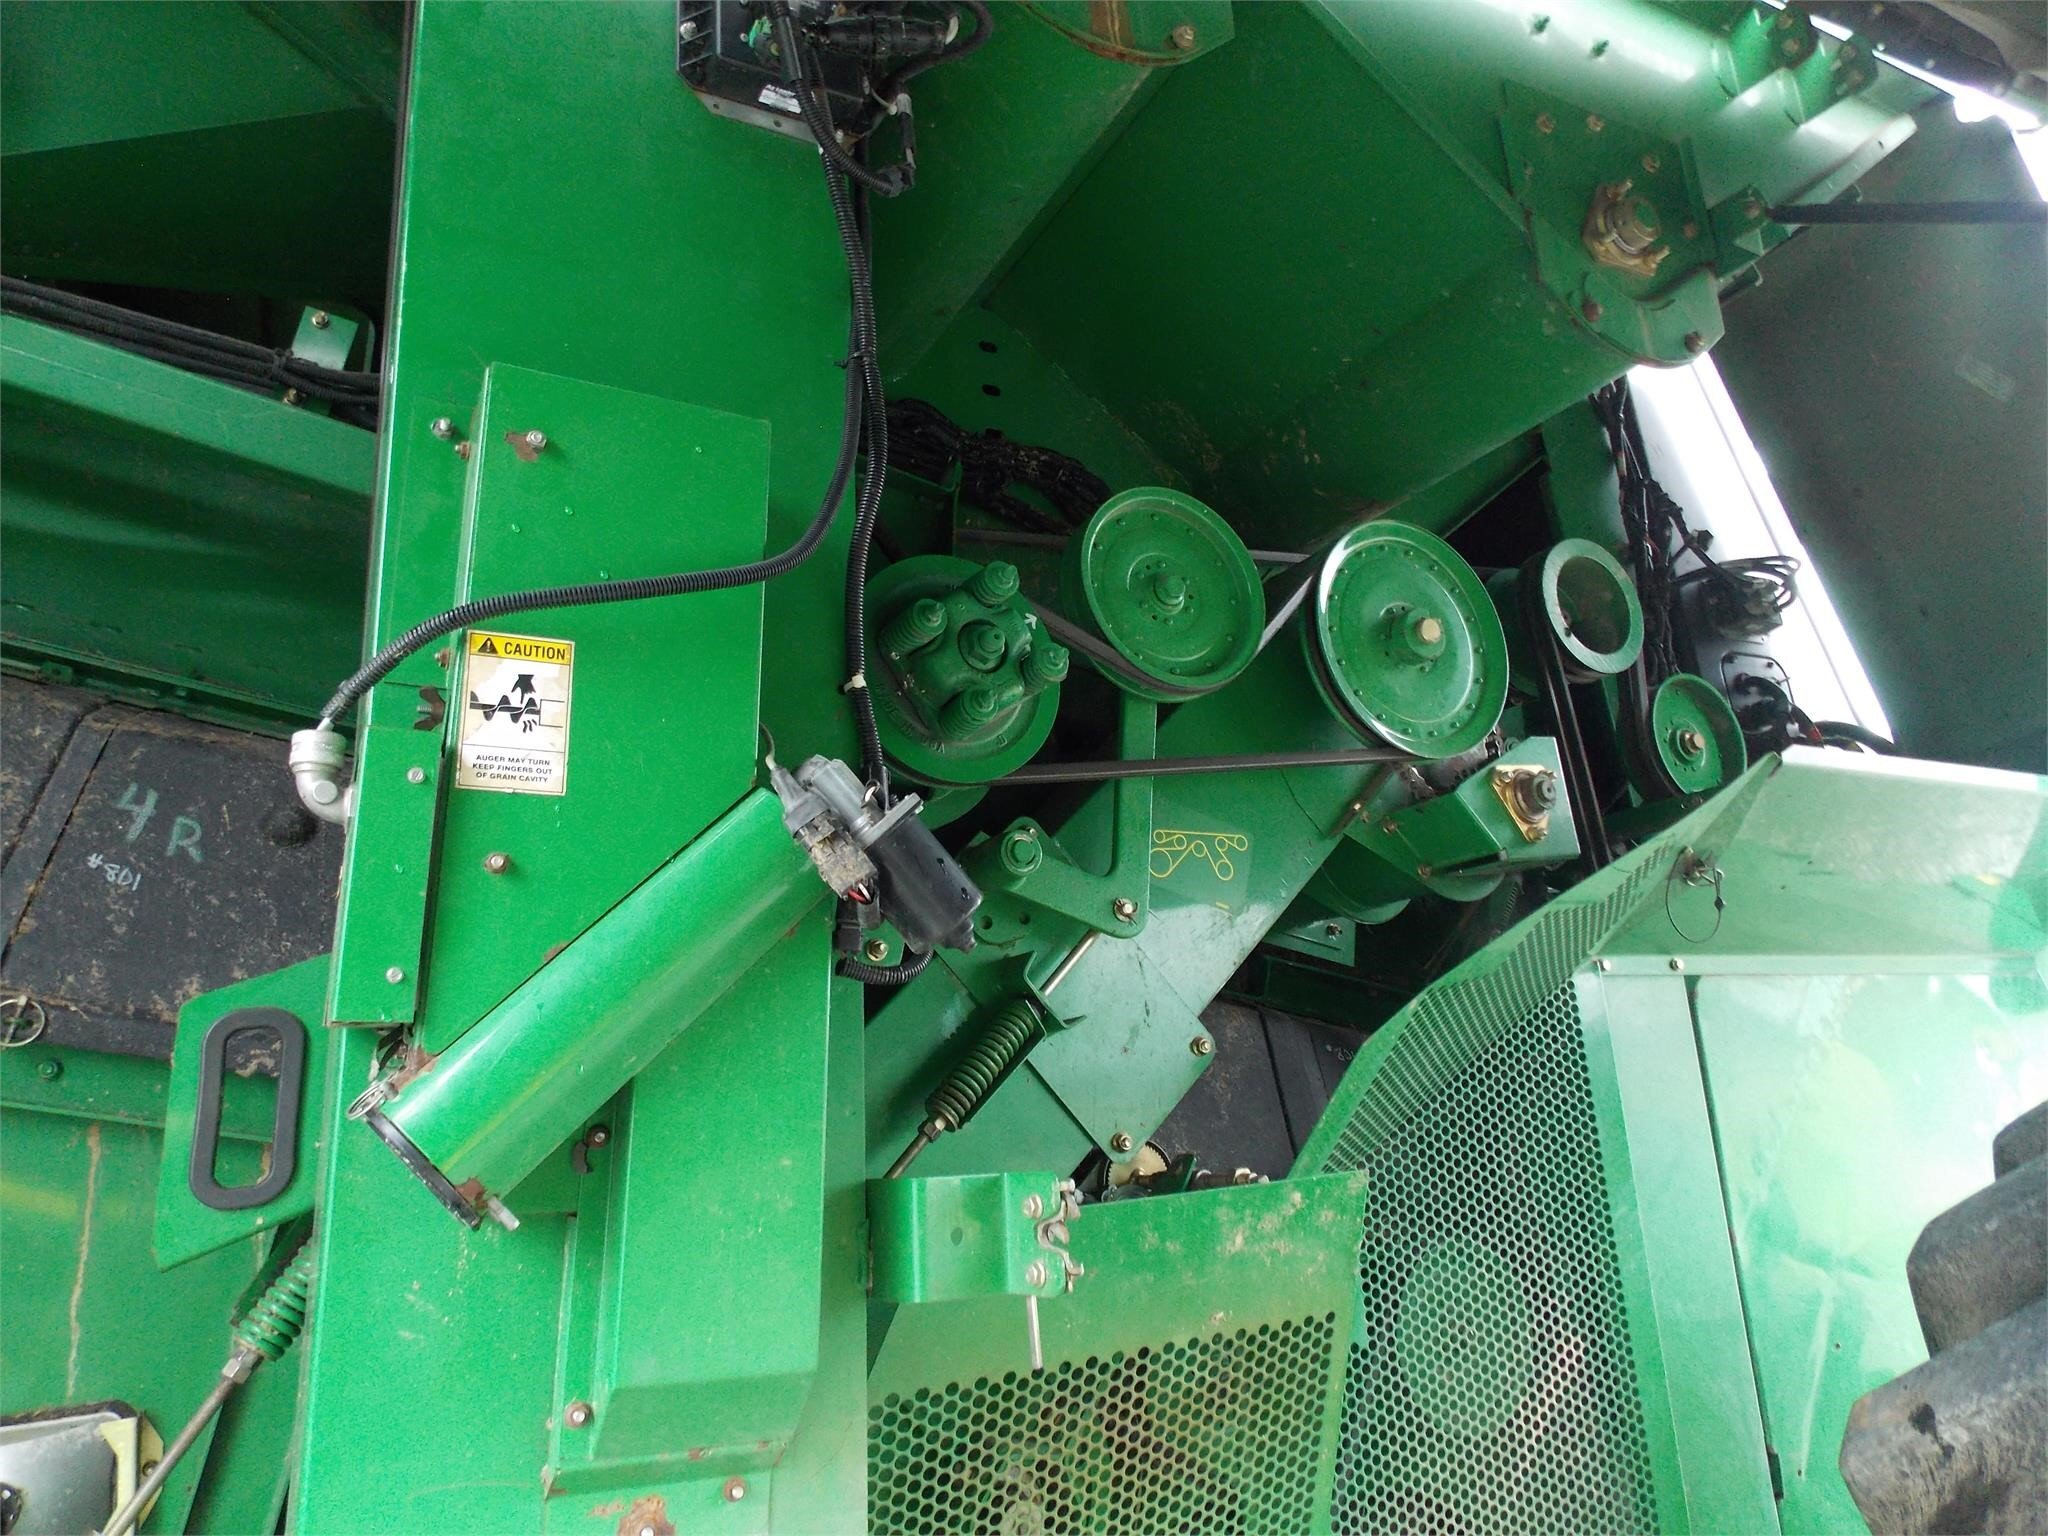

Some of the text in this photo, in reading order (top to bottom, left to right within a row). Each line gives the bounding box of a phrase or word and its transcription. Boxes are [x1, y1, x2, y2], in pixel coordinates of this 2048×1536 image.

[504, 642, 566, 660] CAUTION
[476, 754, 505, 763] AUGER
[528, 758, 550, 766] TURN
[497, 764, 533, 773] FINGERS
[536, 767, 552, 775] OUT
[519, 775, 548, 783] CAVITY
[115, 782, 204, 861] 4 R
